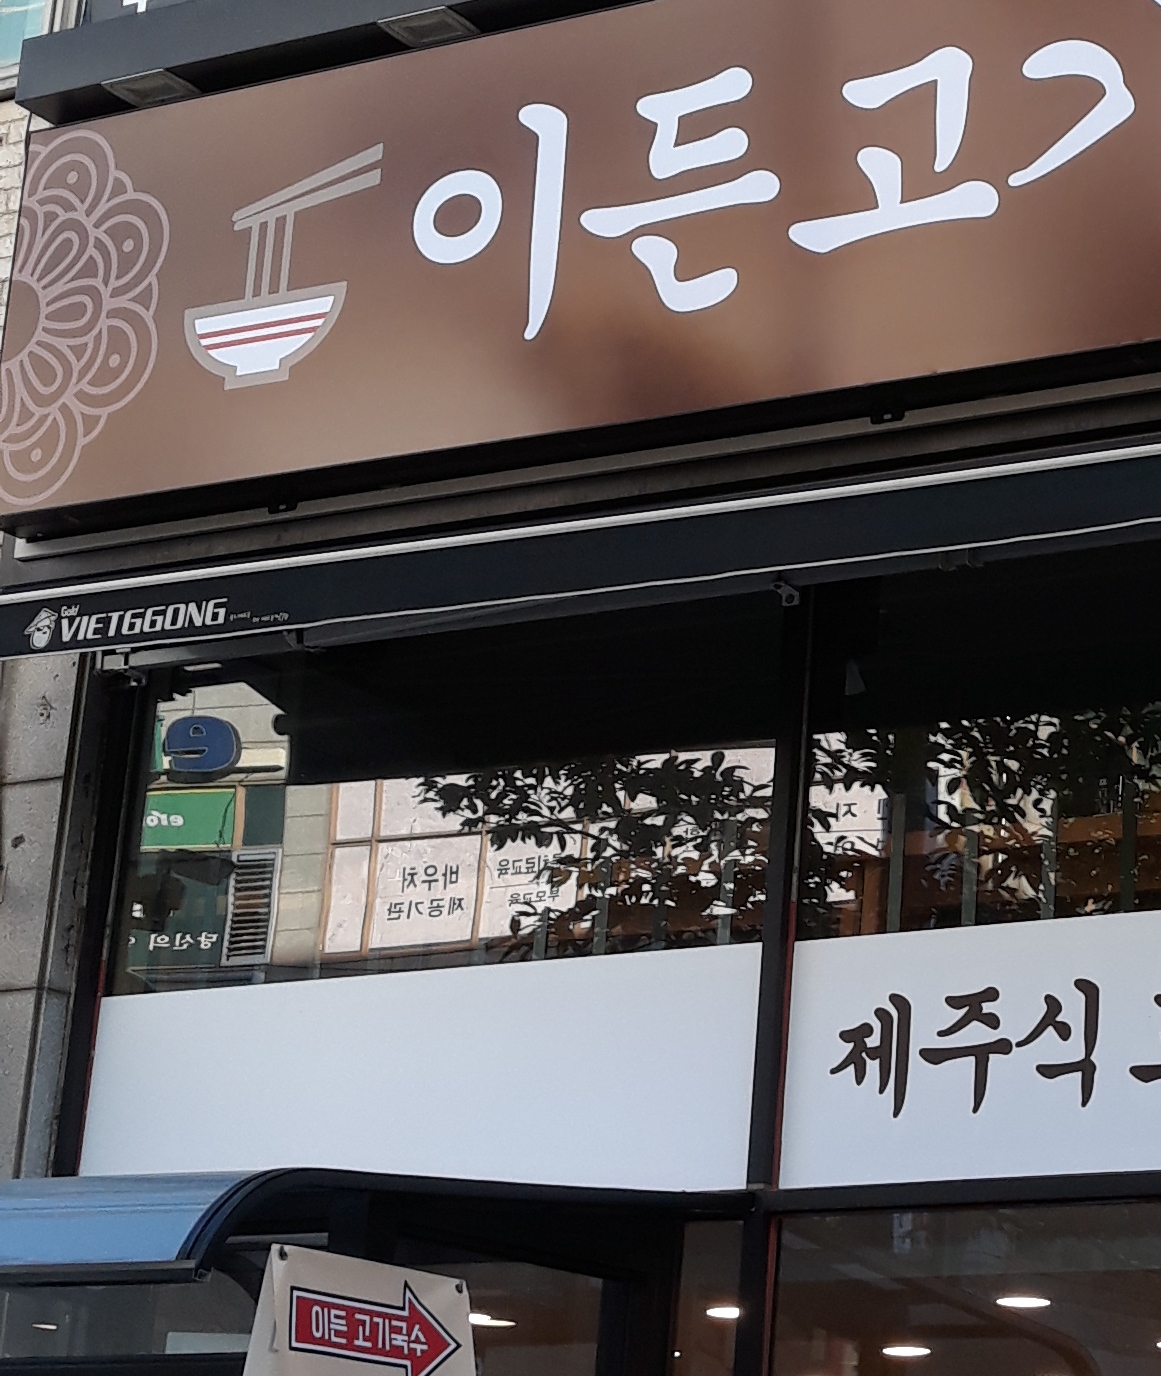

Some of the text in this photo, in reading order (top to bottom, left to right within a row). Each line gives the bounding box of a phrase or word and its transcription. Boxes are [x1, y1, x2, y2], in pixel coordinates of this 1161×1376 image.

[60, 597, 228, 643] VIETGGONG
[61, 604, 80, 618] Gold
[829, 976, 1102, 1120] 제주식
[310, 1304, 429, 1357] 이든 고기국수
